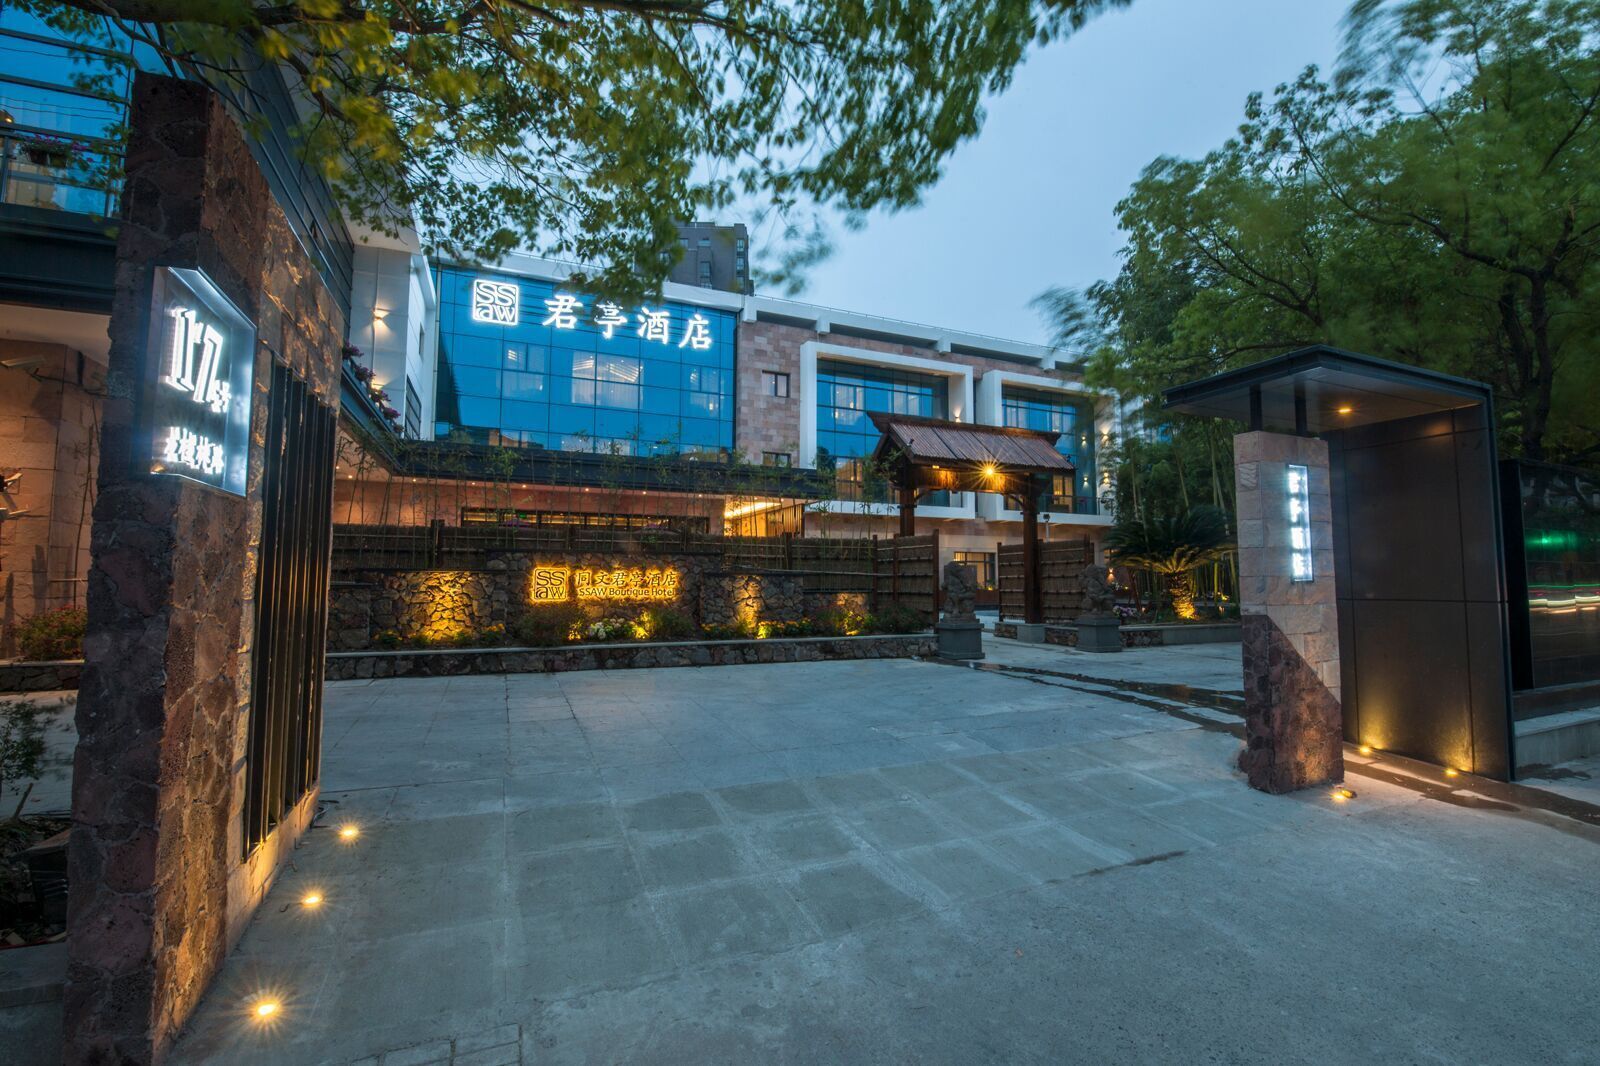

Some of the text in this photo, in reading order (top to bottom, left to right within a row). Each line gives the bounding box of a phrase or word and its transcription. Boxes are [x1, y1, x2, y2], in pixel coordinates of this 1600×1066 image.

[542, 294, 713, 350] 君亭酒店
[579, 587, 676, 598] SSAW Boutique Hotel
